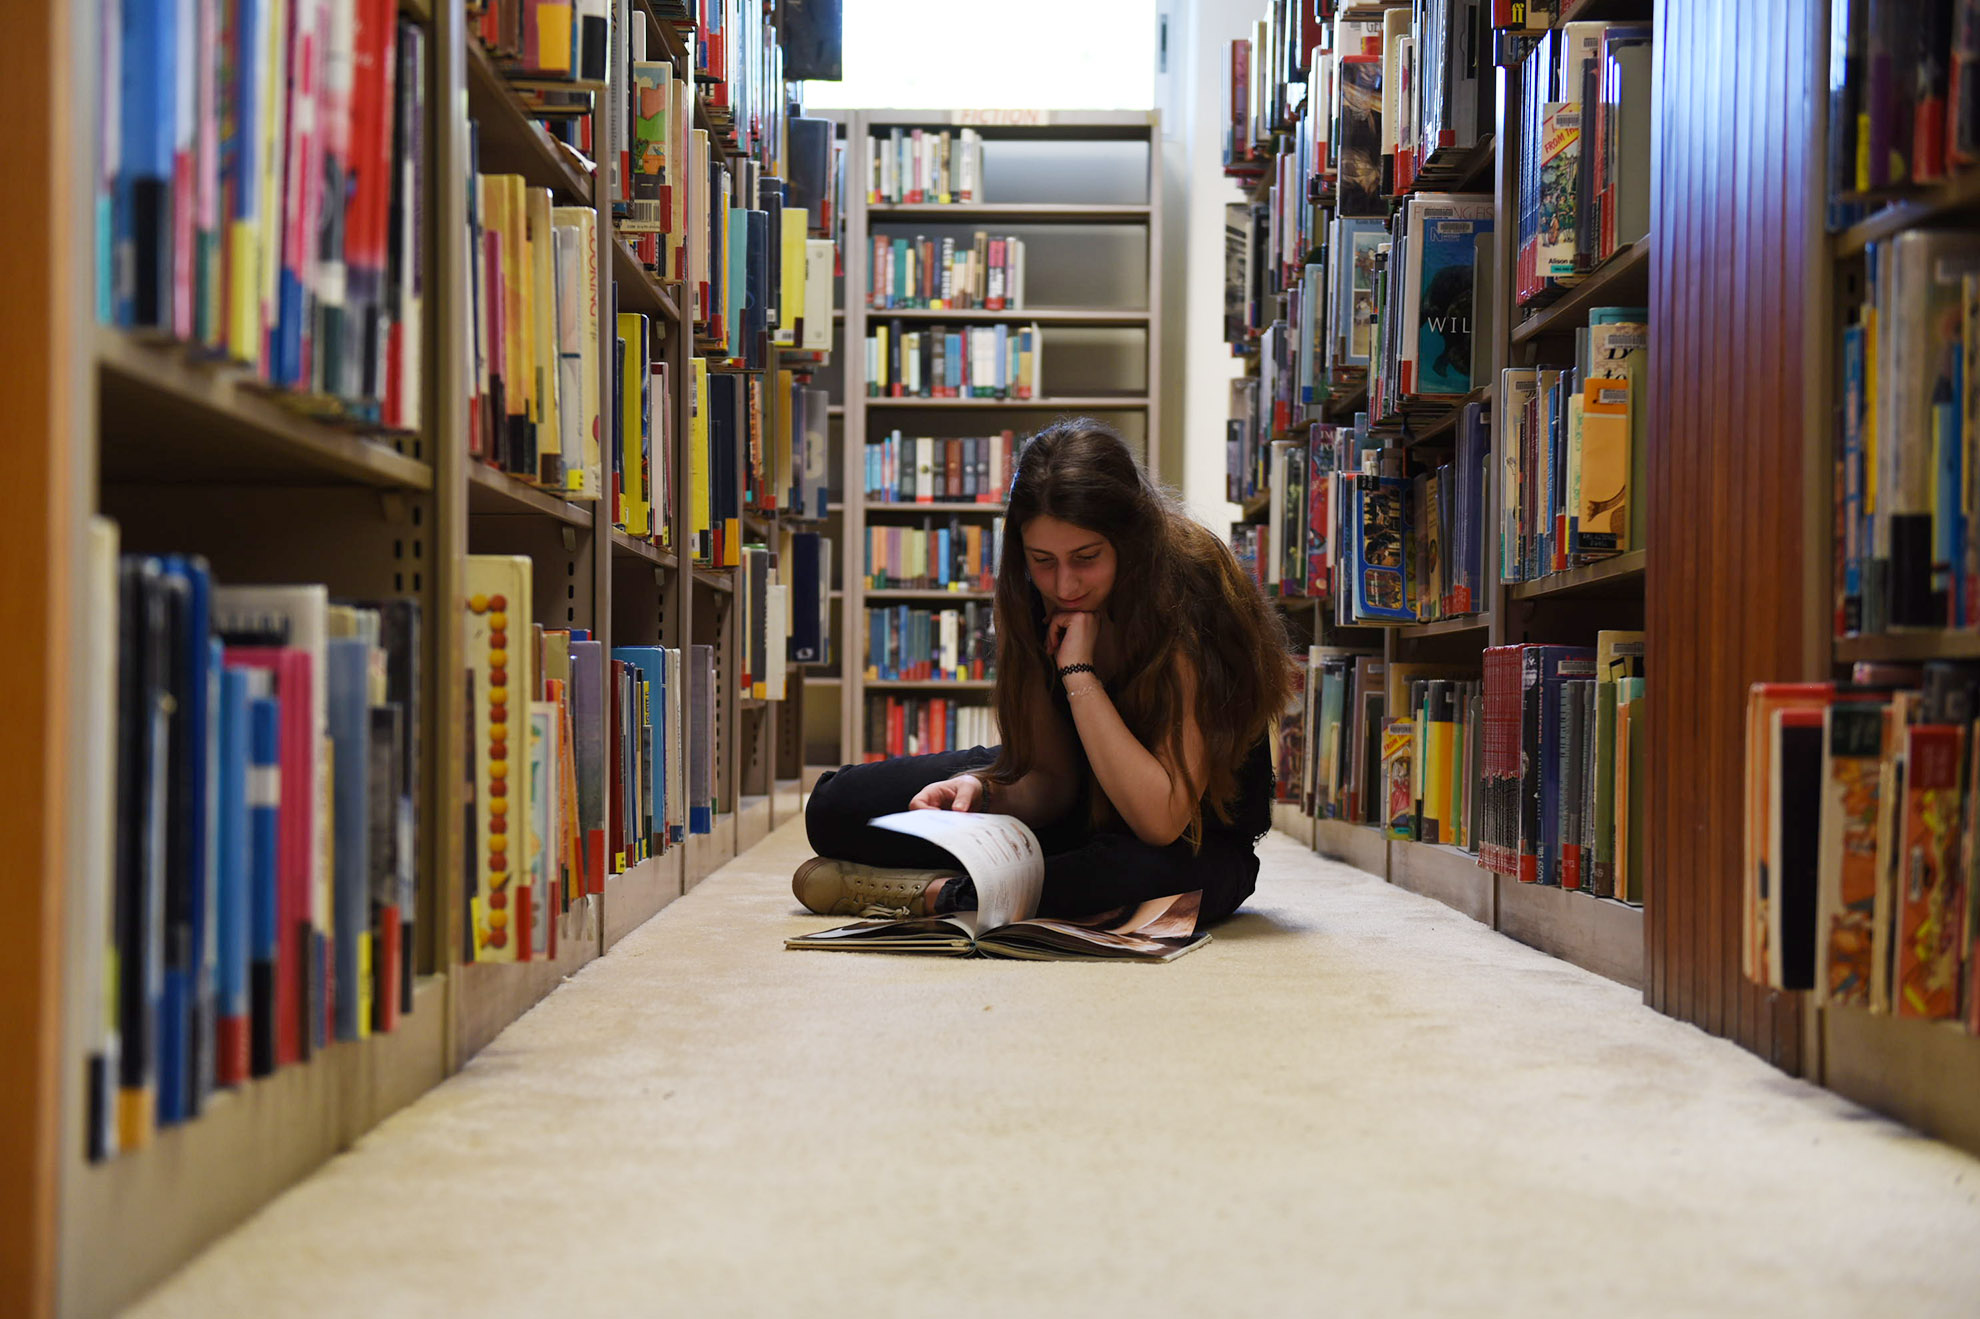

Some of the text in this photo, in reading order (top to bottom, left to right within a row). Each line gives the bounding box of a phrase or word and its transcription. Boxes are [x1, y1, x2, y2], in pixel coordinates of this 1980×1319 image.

[960, 109, 1040, 124] FICTION
[1544, 132, 1566, 153] FROM
[1537, 685, 1545, 744] Armstrong
